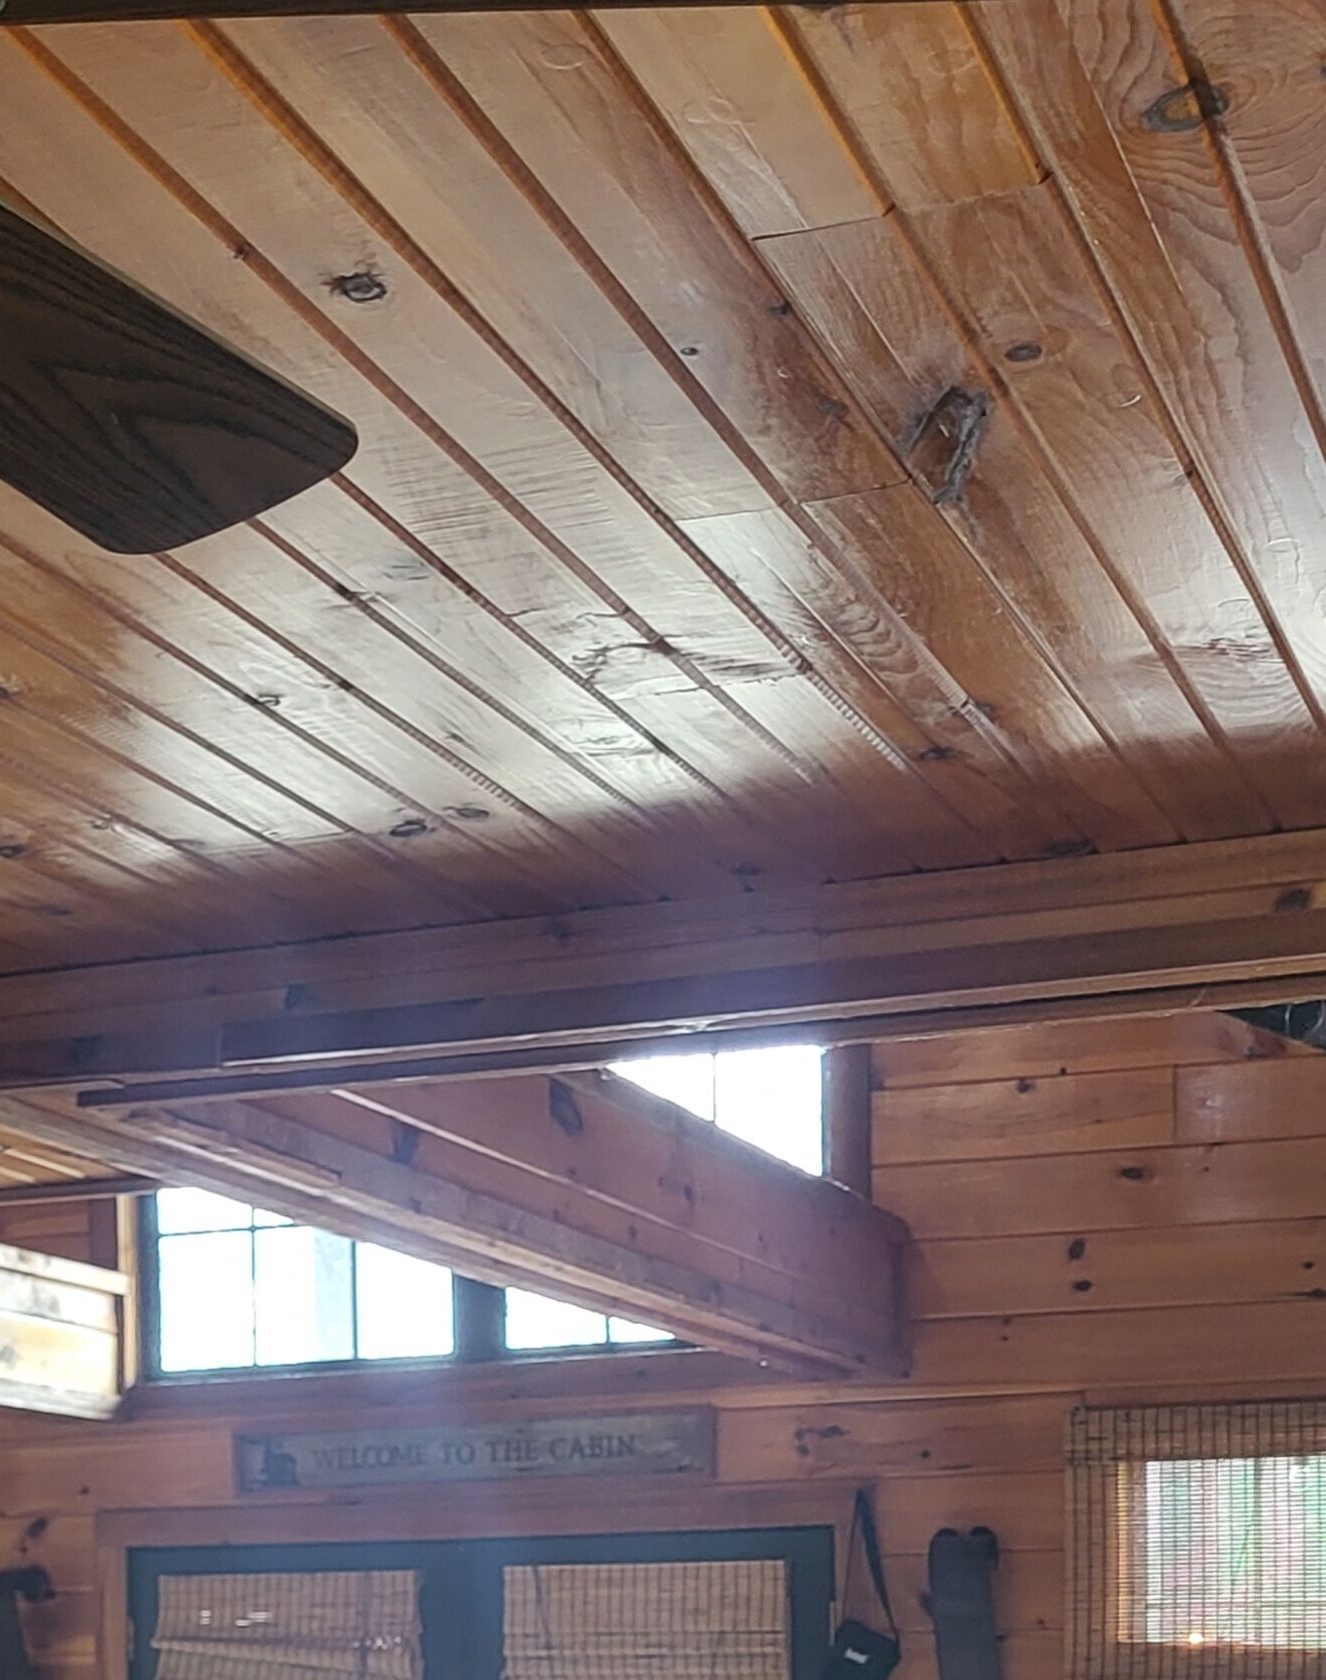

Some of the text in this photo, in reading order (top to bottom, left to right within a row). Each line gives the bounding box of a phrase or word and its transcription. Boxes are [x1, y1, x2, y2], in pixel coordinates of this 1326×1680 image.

[312, 1431, 639, 1470] WELCOME TO THE CABIN
